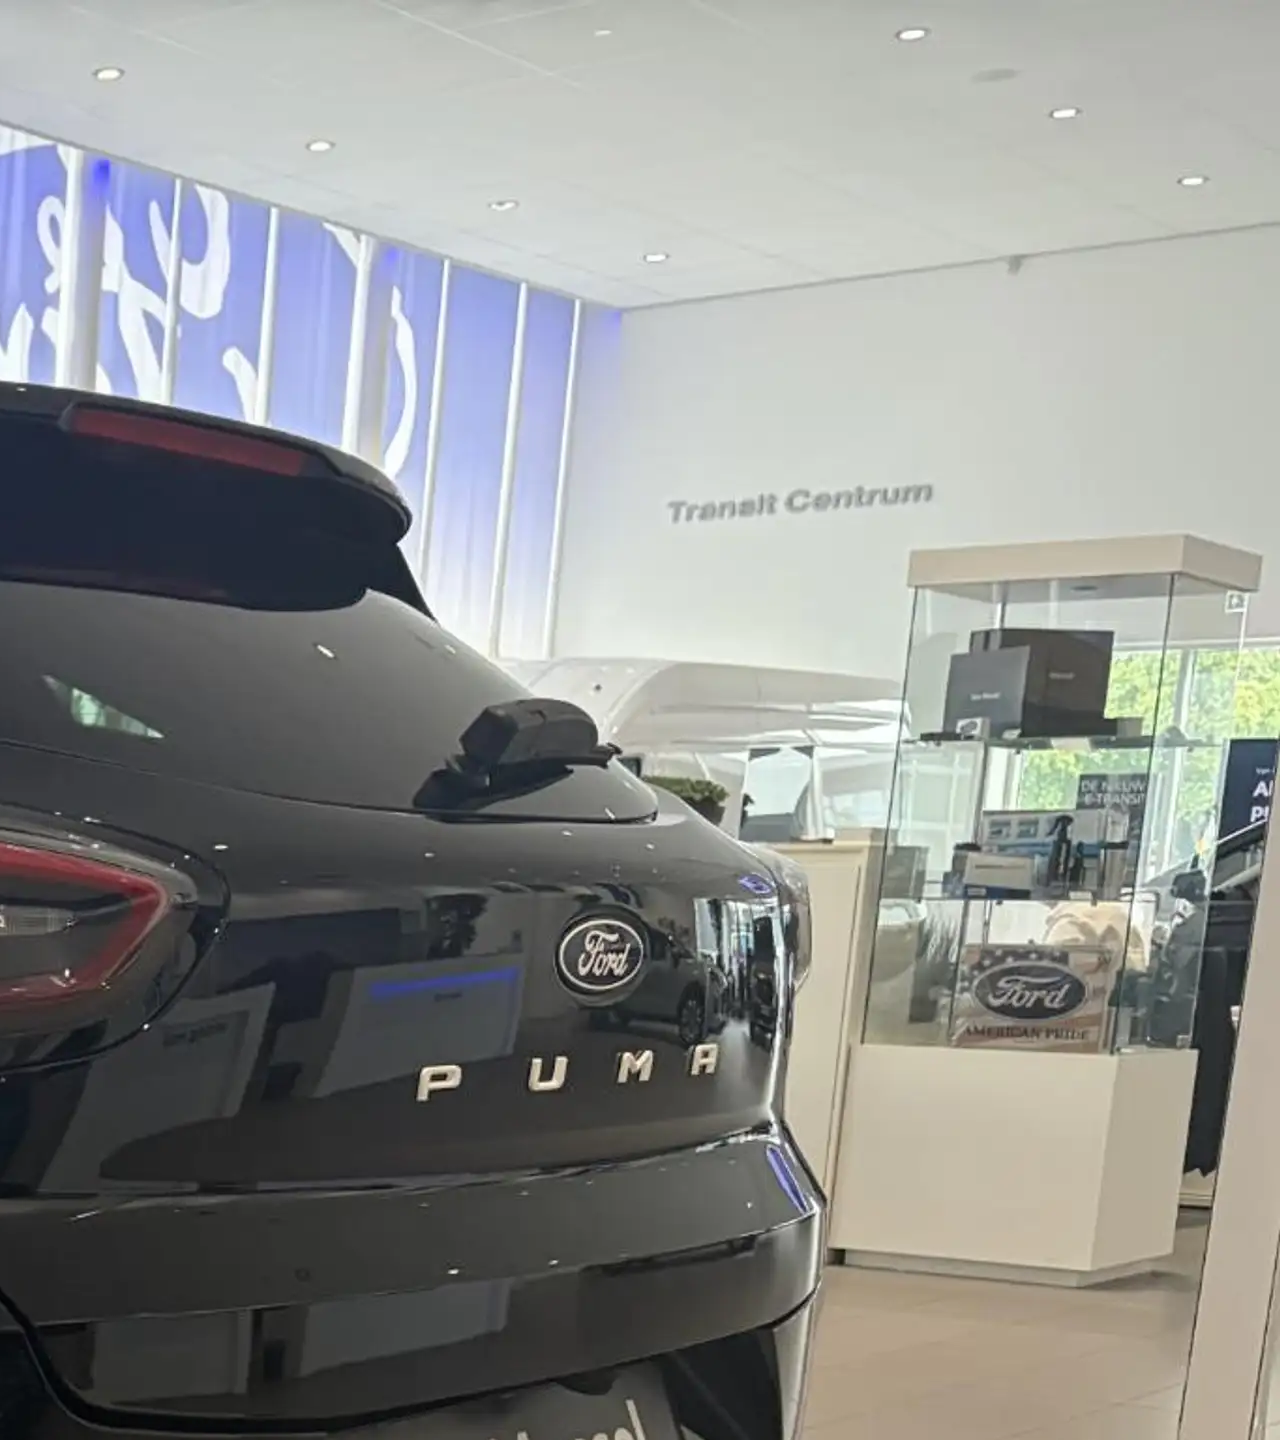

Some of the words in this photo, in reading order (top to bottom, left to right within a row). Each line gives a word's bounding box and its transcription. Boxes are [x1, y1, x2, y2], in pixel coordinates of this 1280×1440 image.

[667, 493, 778, 523] Transit
[784, 484, 933, 513] Centrum
[577, 929, 629, 977] Ford
[989, 974, 1071, 1008] Ford
[964, 1025, 1040, 1041] AMERICAN
[1044, 1028, 1088, 1041] PRIDE
[416, 1043, 720, 1102] PUMA
